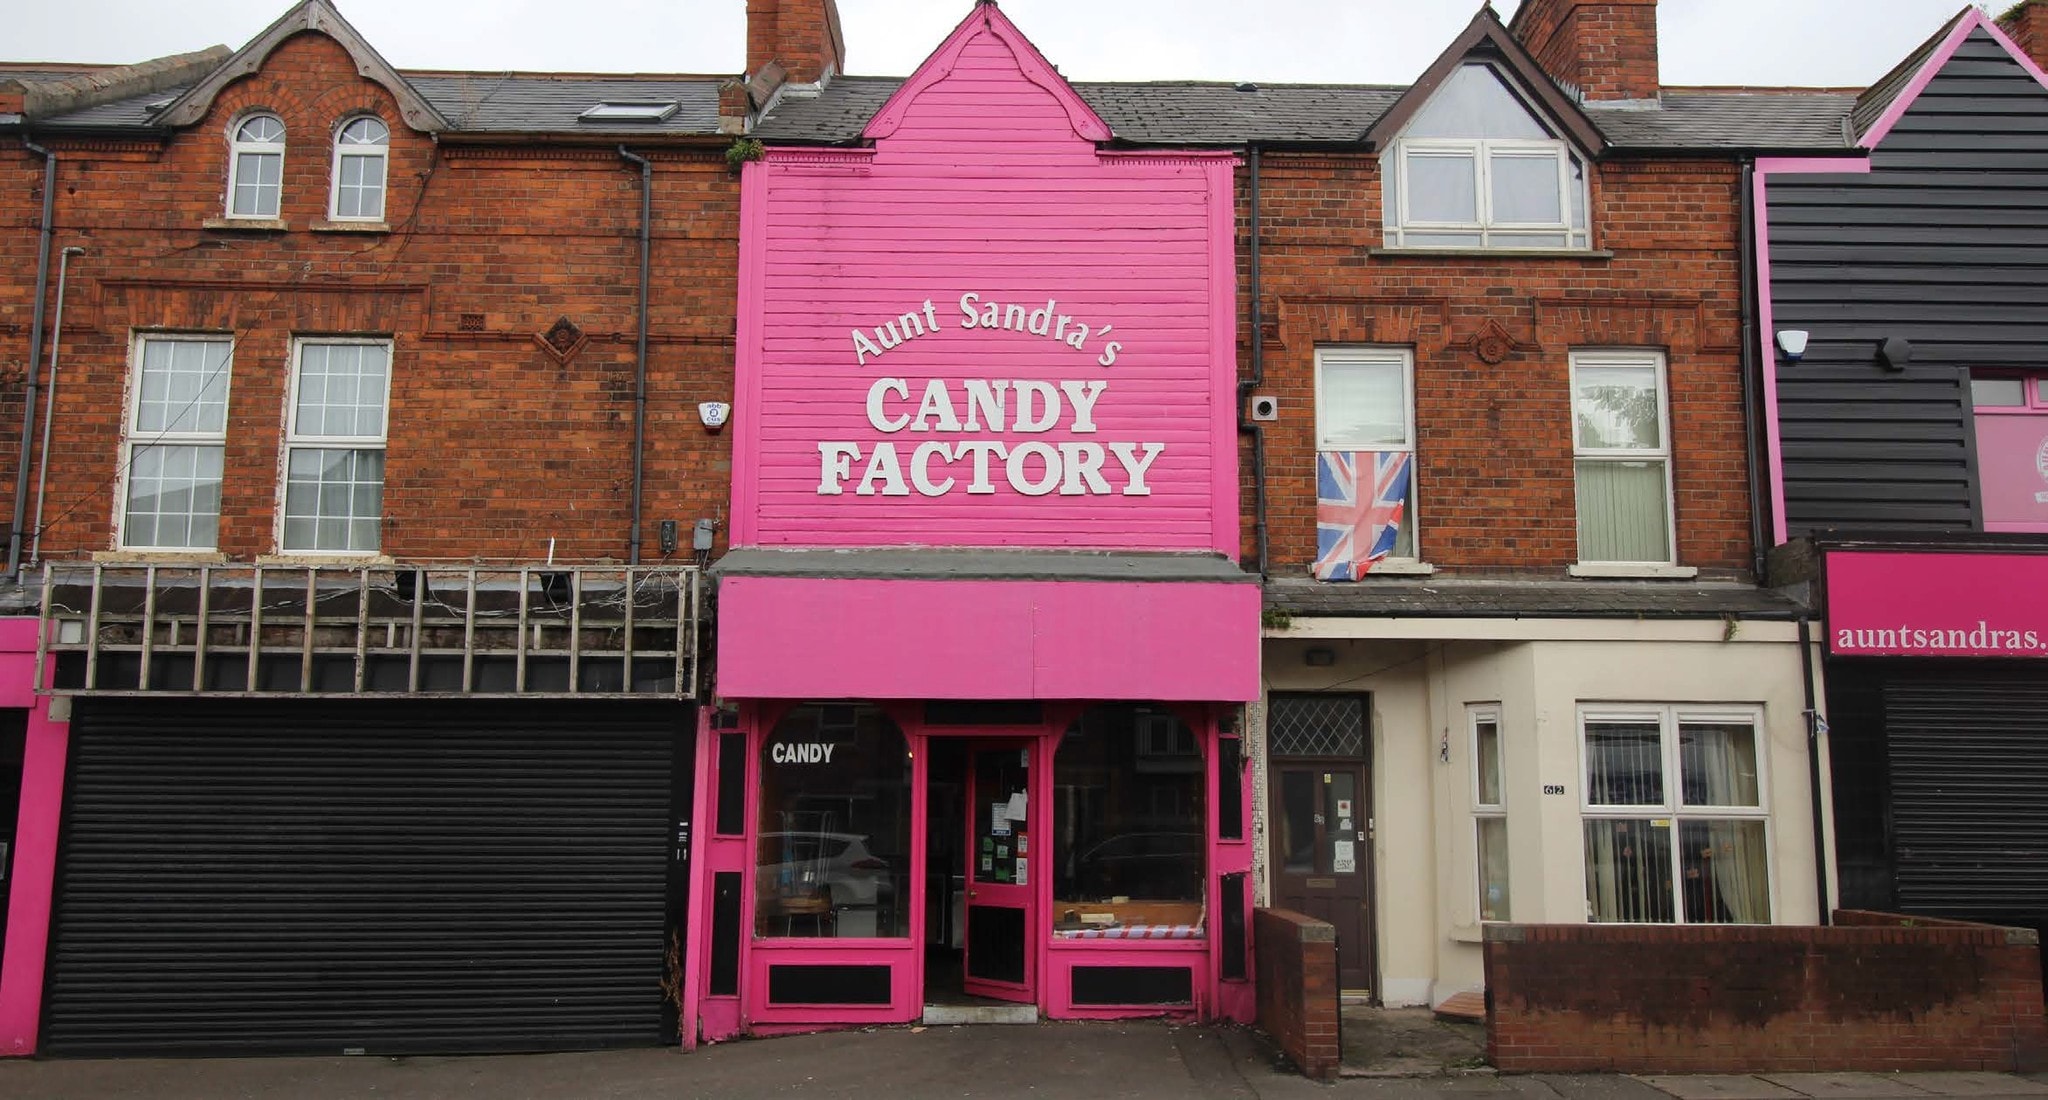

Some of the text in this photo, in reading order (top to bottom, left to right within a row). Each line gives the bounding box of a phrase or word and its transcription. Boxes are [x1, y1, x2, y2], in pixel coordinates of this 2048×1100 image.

[851, 299, 941, 366] Aunt
[866, 377, 1108, 433] CANDY
[816, 441, 1165, 496] FACTORY
[772, 742, 835, 764] CANDY
[1544, 785, 1564, 795] 62
